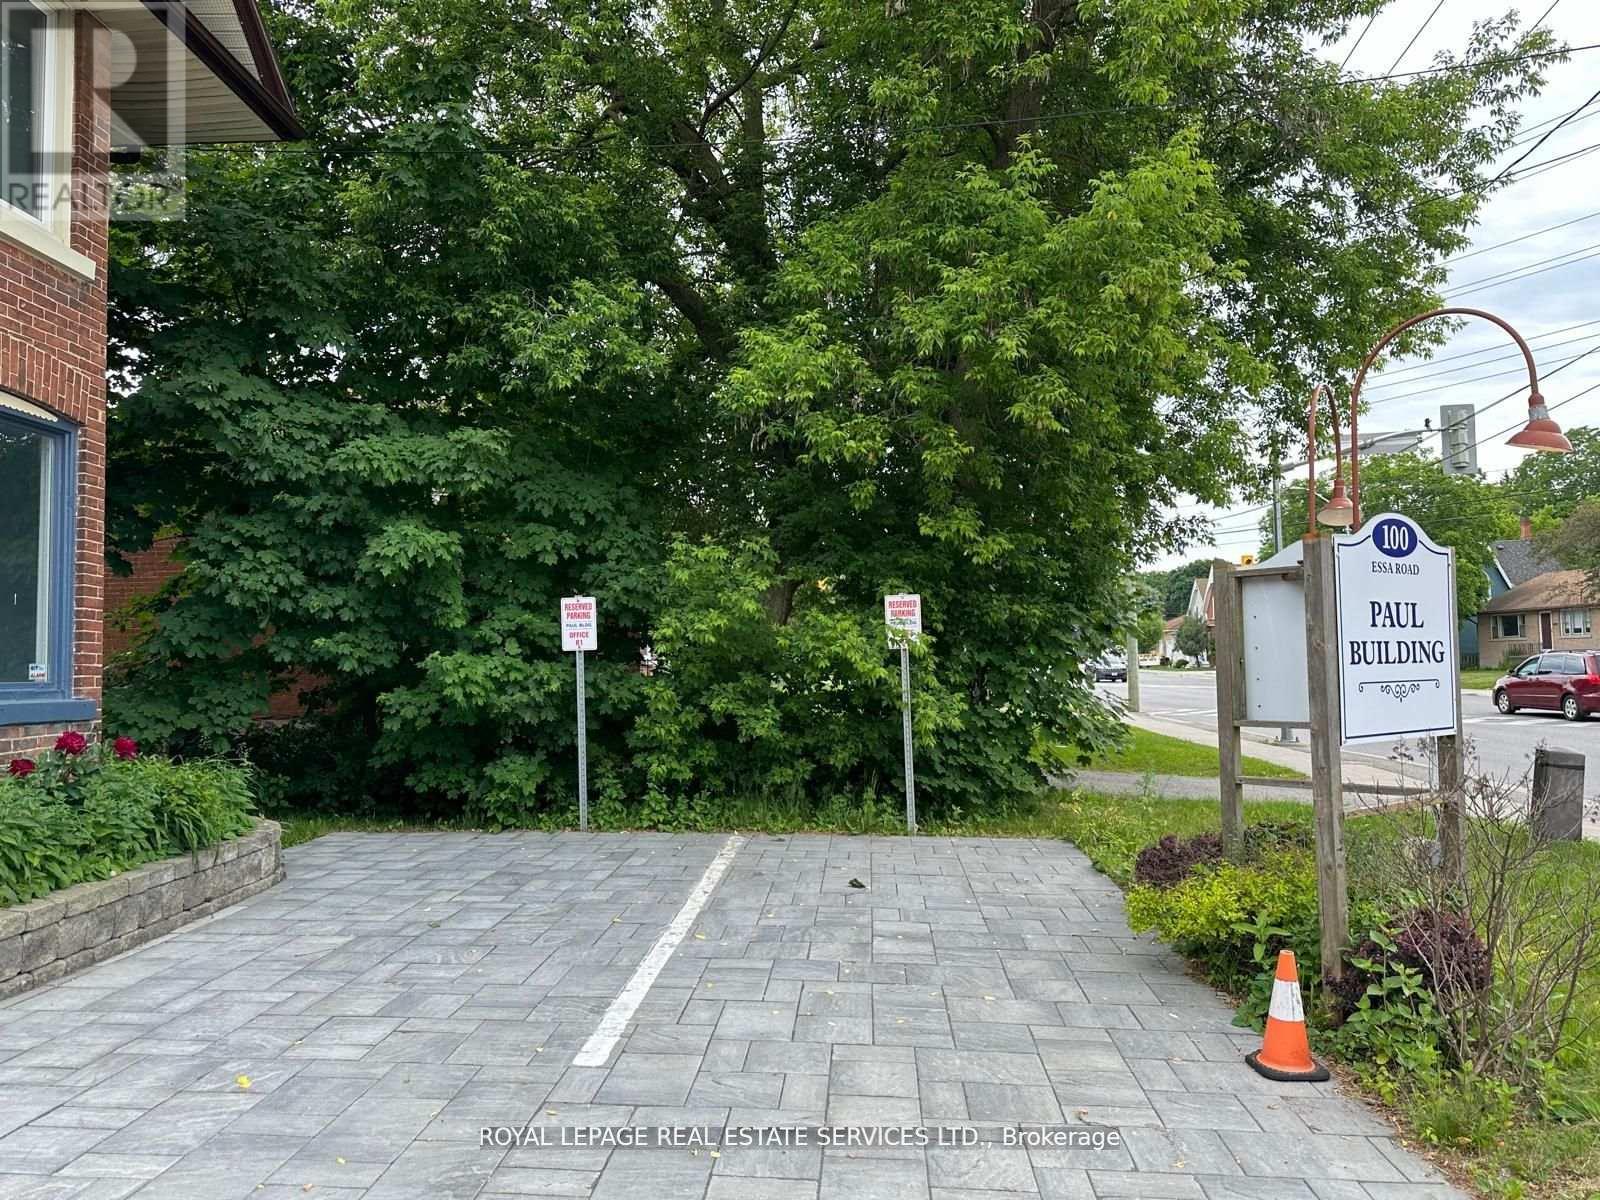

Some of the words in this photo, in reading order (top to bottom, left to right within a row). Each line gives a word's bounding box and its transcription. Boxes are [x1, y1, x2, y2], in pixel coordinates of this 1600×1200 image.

[1382, 525, 1409, 551] 100
[1371, 561, 1394, 575] ESSA
[1395, 562, 1420, 576] ROAD
[565, 603, 592, 611] RESERVED
[888, 600, 917, 608] RESERVED
[1369, 601, 1424, 629] PAUL
[1349, 640, 1445, 665] BUILDING
